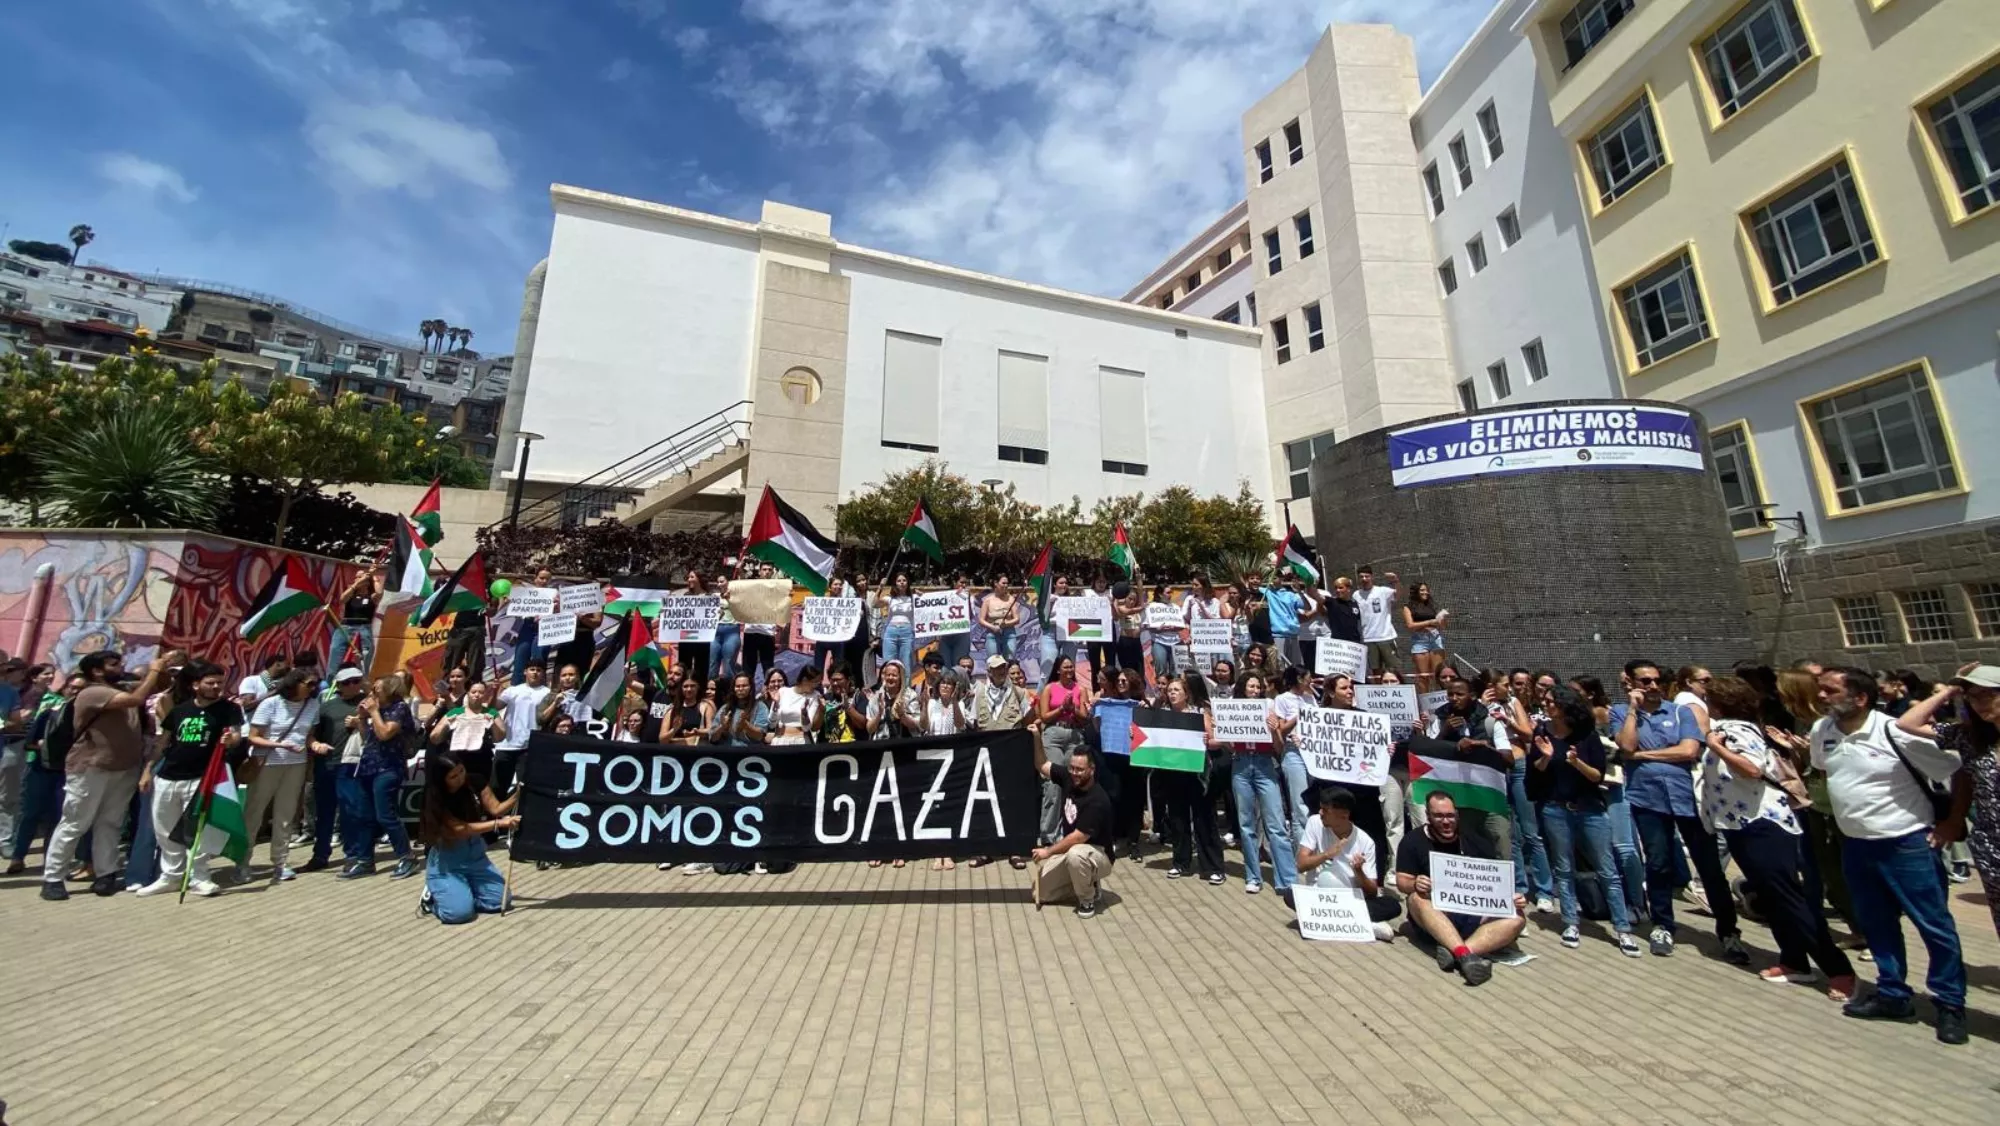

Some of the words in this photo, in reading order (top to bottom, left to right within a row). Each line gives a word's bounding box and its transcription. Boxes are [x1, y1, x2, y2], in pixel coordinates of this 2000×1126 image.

[1471, 412, 1638, 439] ELIMINEMOS
[1403, 447, 1438, 467] LAS
[1444, 431, 1586, 459] VIOLENCIAS
[1593, 430, 1692, 449] MACHISTAS
[563, 600, 598, 610] PALESTINA
[663, 597, 674, 608] NO
[820, 599, 834, 608] QUE
[836, 599, 856, 609] ALAS
[704, 608, 717, 618] ES
[1149, 606, 1180, 614] BOICOT
[805, 616, 828, 625] SOCIAL
[832, 617, 842, 626] TE
[915, 623, 927, 633] SE
[543, 629, 572, 639] PALESTINA
[1193, 638, 1230, 646] PALESTINA
[1392, 690, 1403, 698] AL
[1216, 703, 1240, 711] ISRAEL
[1241, 703, 1262, 711] ROBA
[1367, 701, 1406, 709] SILENCIO
[1253, 714, 1264, 722] DE
[1323, 712, 1345, 726] QUE
[1217, 726, 1267, 735] PALESTINA
[1300, 722, 1313, 738] LA
[1300, 738, 1336, 755] SOCIAL
[1340, 742, 1356, 758] TE
[1363, 745, 1378, 760] DA
[563, 752, 772, 798] TODOS
[814, 747, 1006, 845] GAZA
[555, 802, 764, 849] SOMOS
[1444, 870, 1474, 881] PUEDES
[1475, 875, 1501, 883] HACER
[1453, 881, 1476, 891] ALGO
[1476, 885, 1493, 893] POR
[1318, 893, 1338, 904] PAZ
[1440, 891, 1508, 909] PALESTINA
[1310, 907, 1355, 919] JUSTICIA
[1302, 921, 1370, 934] REPARACIÓN
